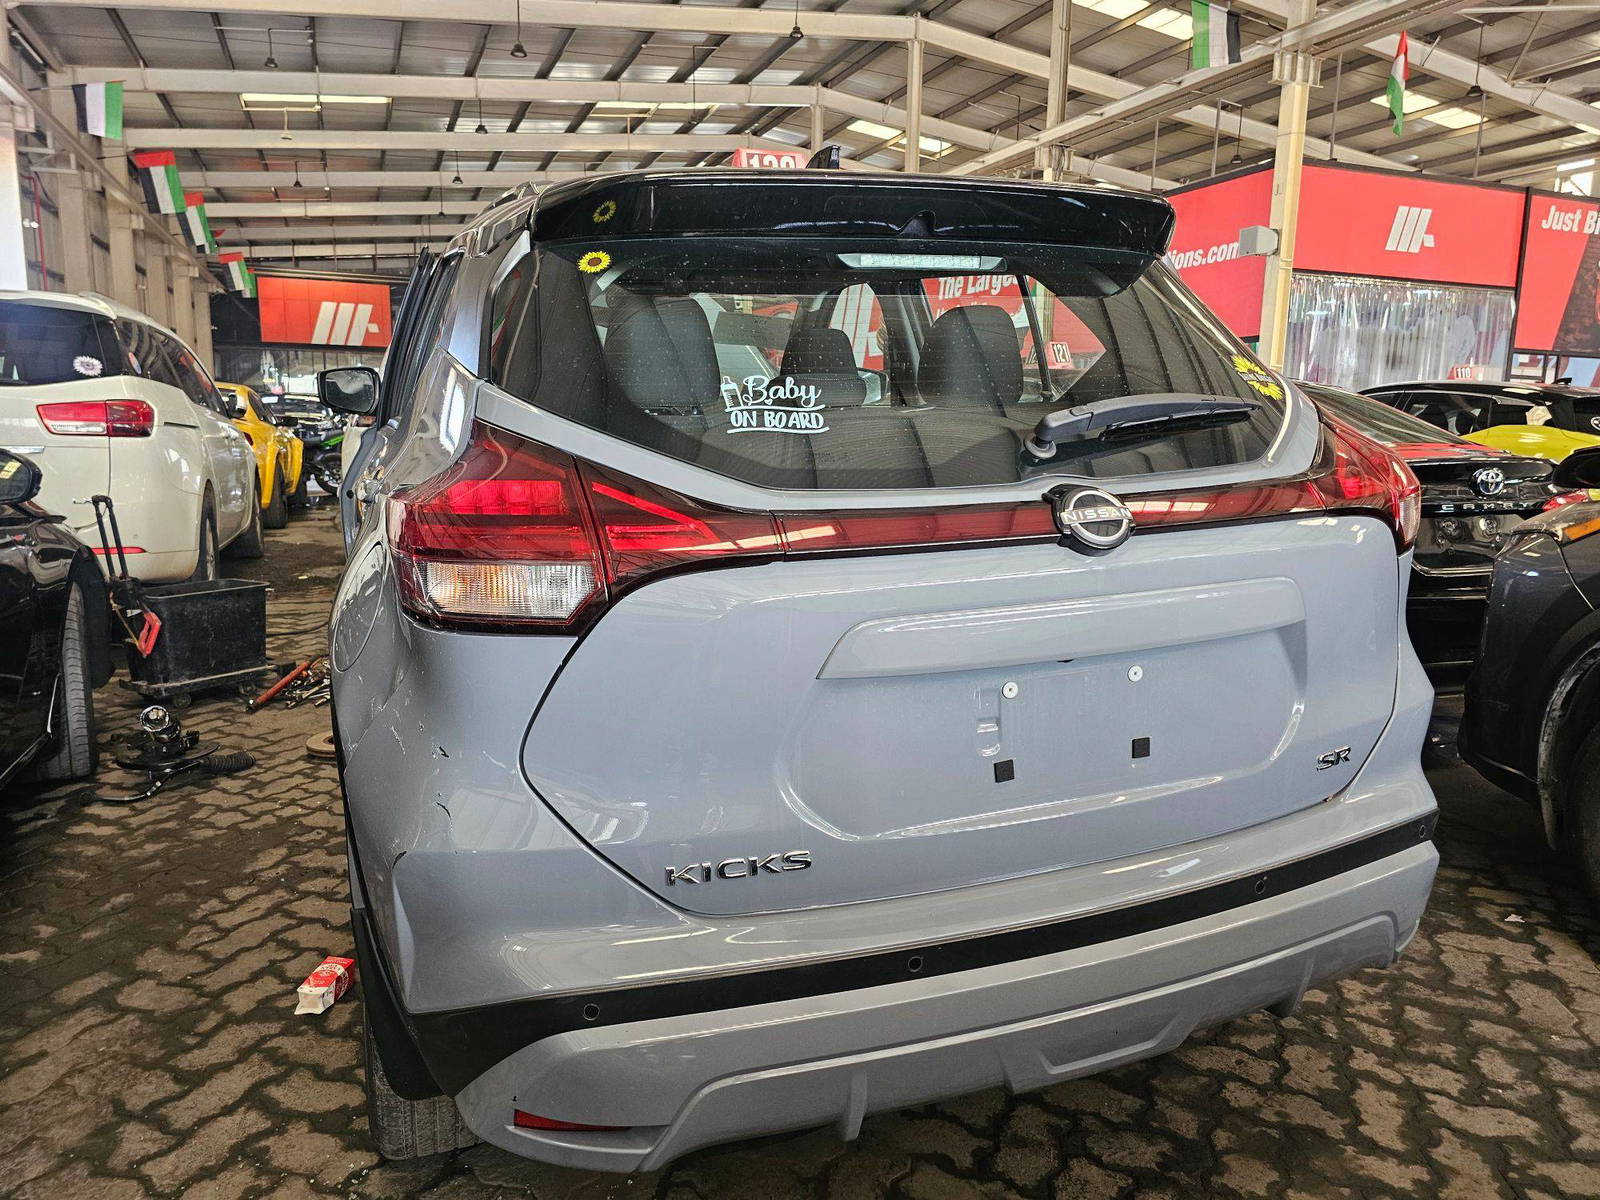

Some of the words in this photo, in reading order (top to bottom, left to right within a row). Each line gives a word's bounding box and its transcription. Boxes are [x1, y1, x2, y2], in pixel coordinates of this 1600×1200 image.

[1541, 205, 1582, 232] Just
[1164, 241, 1240, 270] ions.com
[938, 277, 963, 300] The
[1053, 343, 1073, 363] 121
[1456, 367, 1471, 378] 110
[742, 375, 822, 408] Baby
[730, 410, 757, 427] ON
[763, 411, 824, 428] BOARD
[1063, 507, 1132, 523] NISSAN
[1441, 502, 1529, 511] CAMRY
[1316, 746, 1351, 772] SR
[665, 850, 812, 887] KICKS
